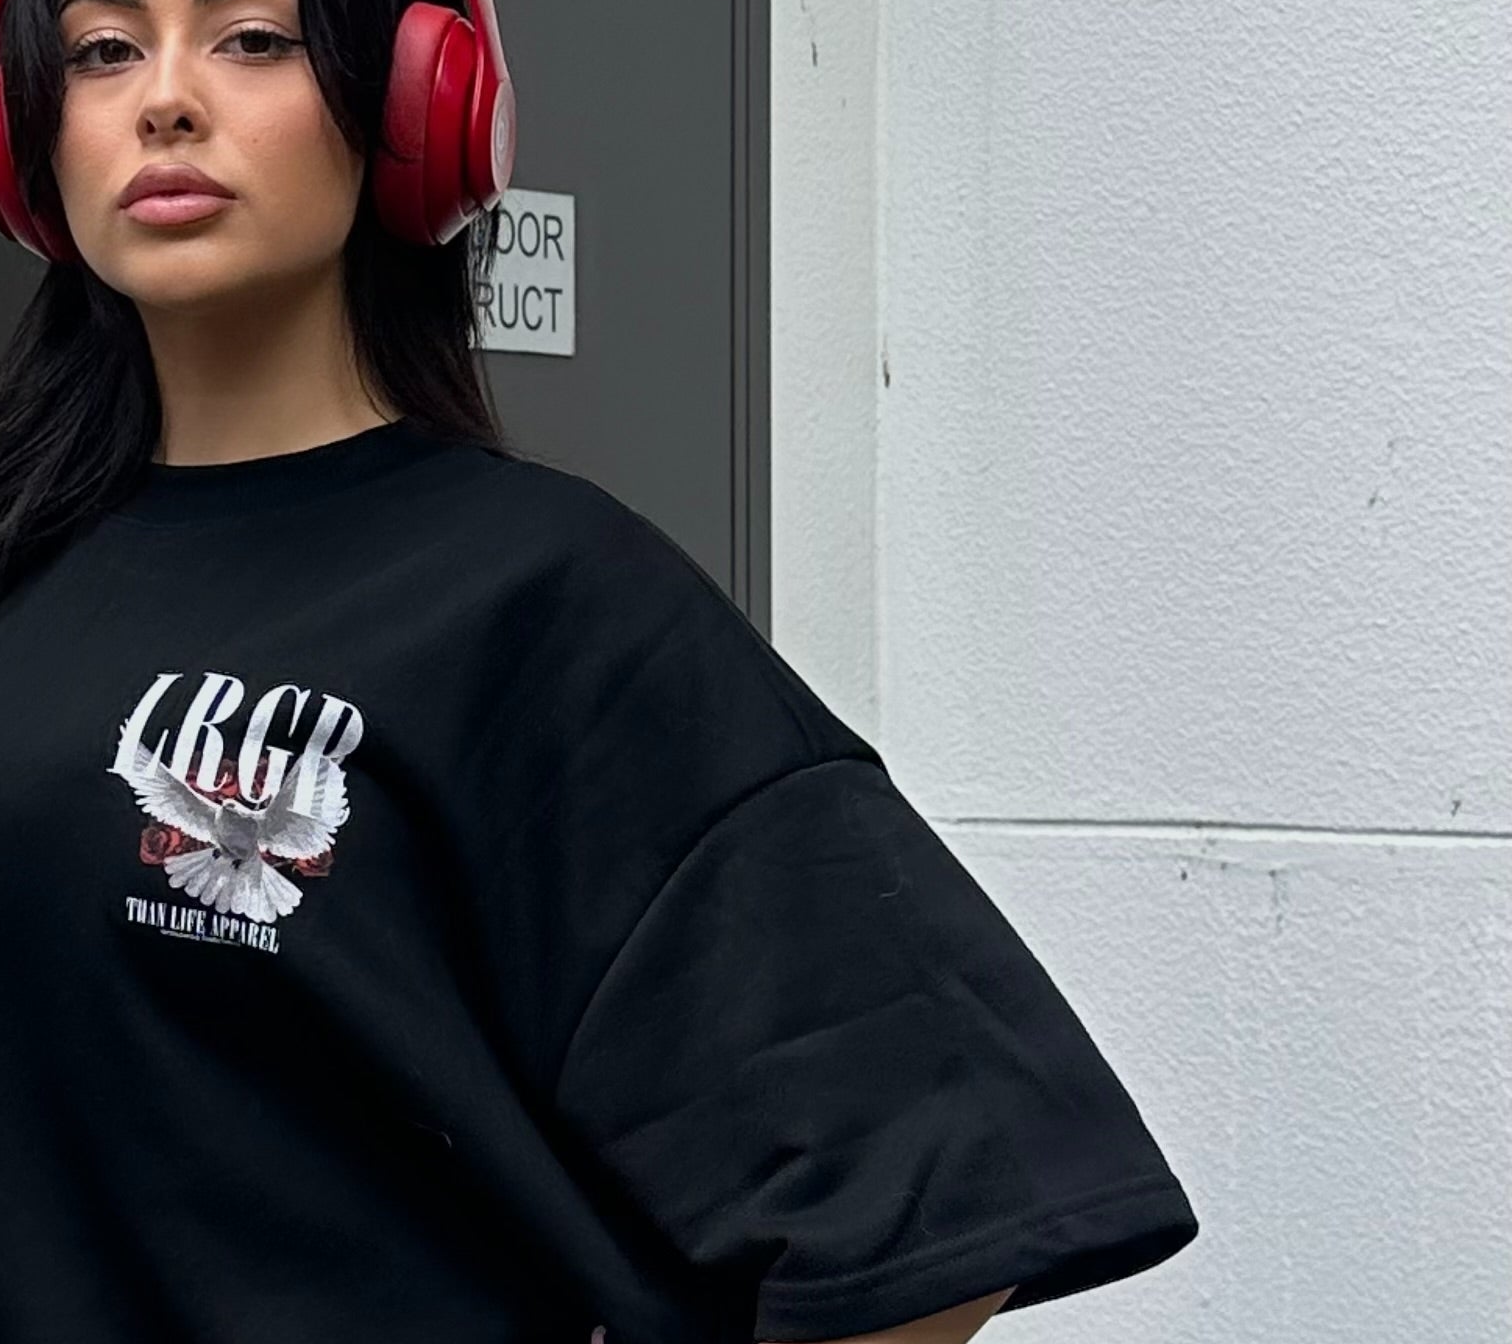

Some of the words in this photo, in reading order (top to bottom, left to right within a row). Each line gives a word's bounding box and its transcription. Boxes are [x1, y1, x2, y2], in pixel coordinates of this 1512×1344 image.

[495, 208, 565, 261] OOR
[475, 280, 564, 334] RUCT
[125, 896, 167, 928] THAN
[170, 905, 207, 937] LIFE
[210, 914, 281, 954] APPAREL
